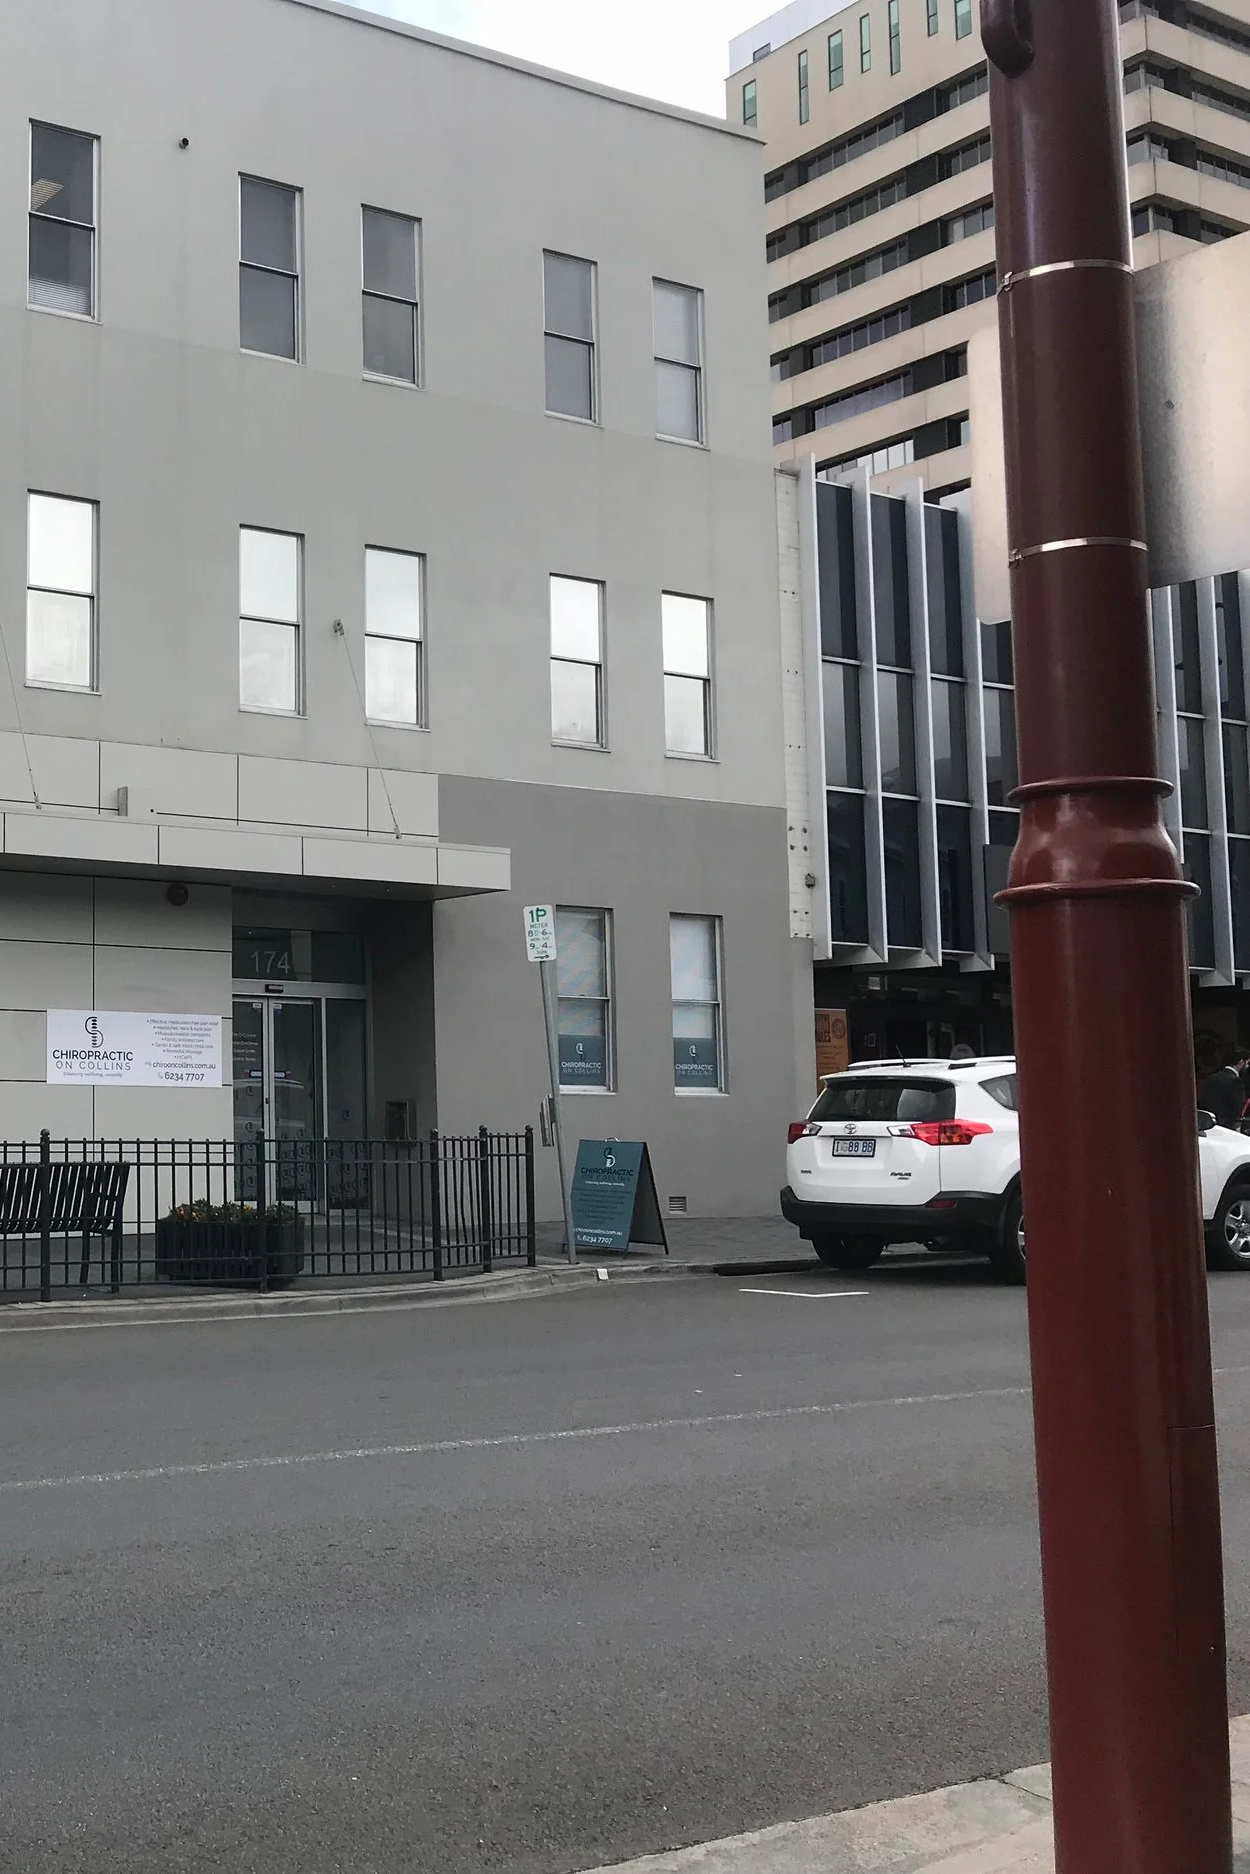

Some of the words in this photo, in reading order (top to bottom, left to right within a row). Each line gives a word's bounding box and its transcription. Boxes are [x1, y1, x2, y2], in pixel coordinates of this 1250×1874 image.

[529, 907, 547, 923] 1P
[251, 950, 291, 975] 174
[52, 1049, 134, 1062] CHIROPRACTIC
[55, 1060, 73, 1070] ON
[78, 1061, 132, 1071] COLLINS
[152, 1061, 217, 1070] chirooncollins.com.au
[561, 1061, 602, 1069] CHIROPRACTIC
[675, 1063, 714, 1071] CHIROPRACTIC
[164, 1071, 184, 1082] 6234
[185, 1073, 205, 1082] 7707
[580, 1166, 635, 1177] CHIROPRACTIC
